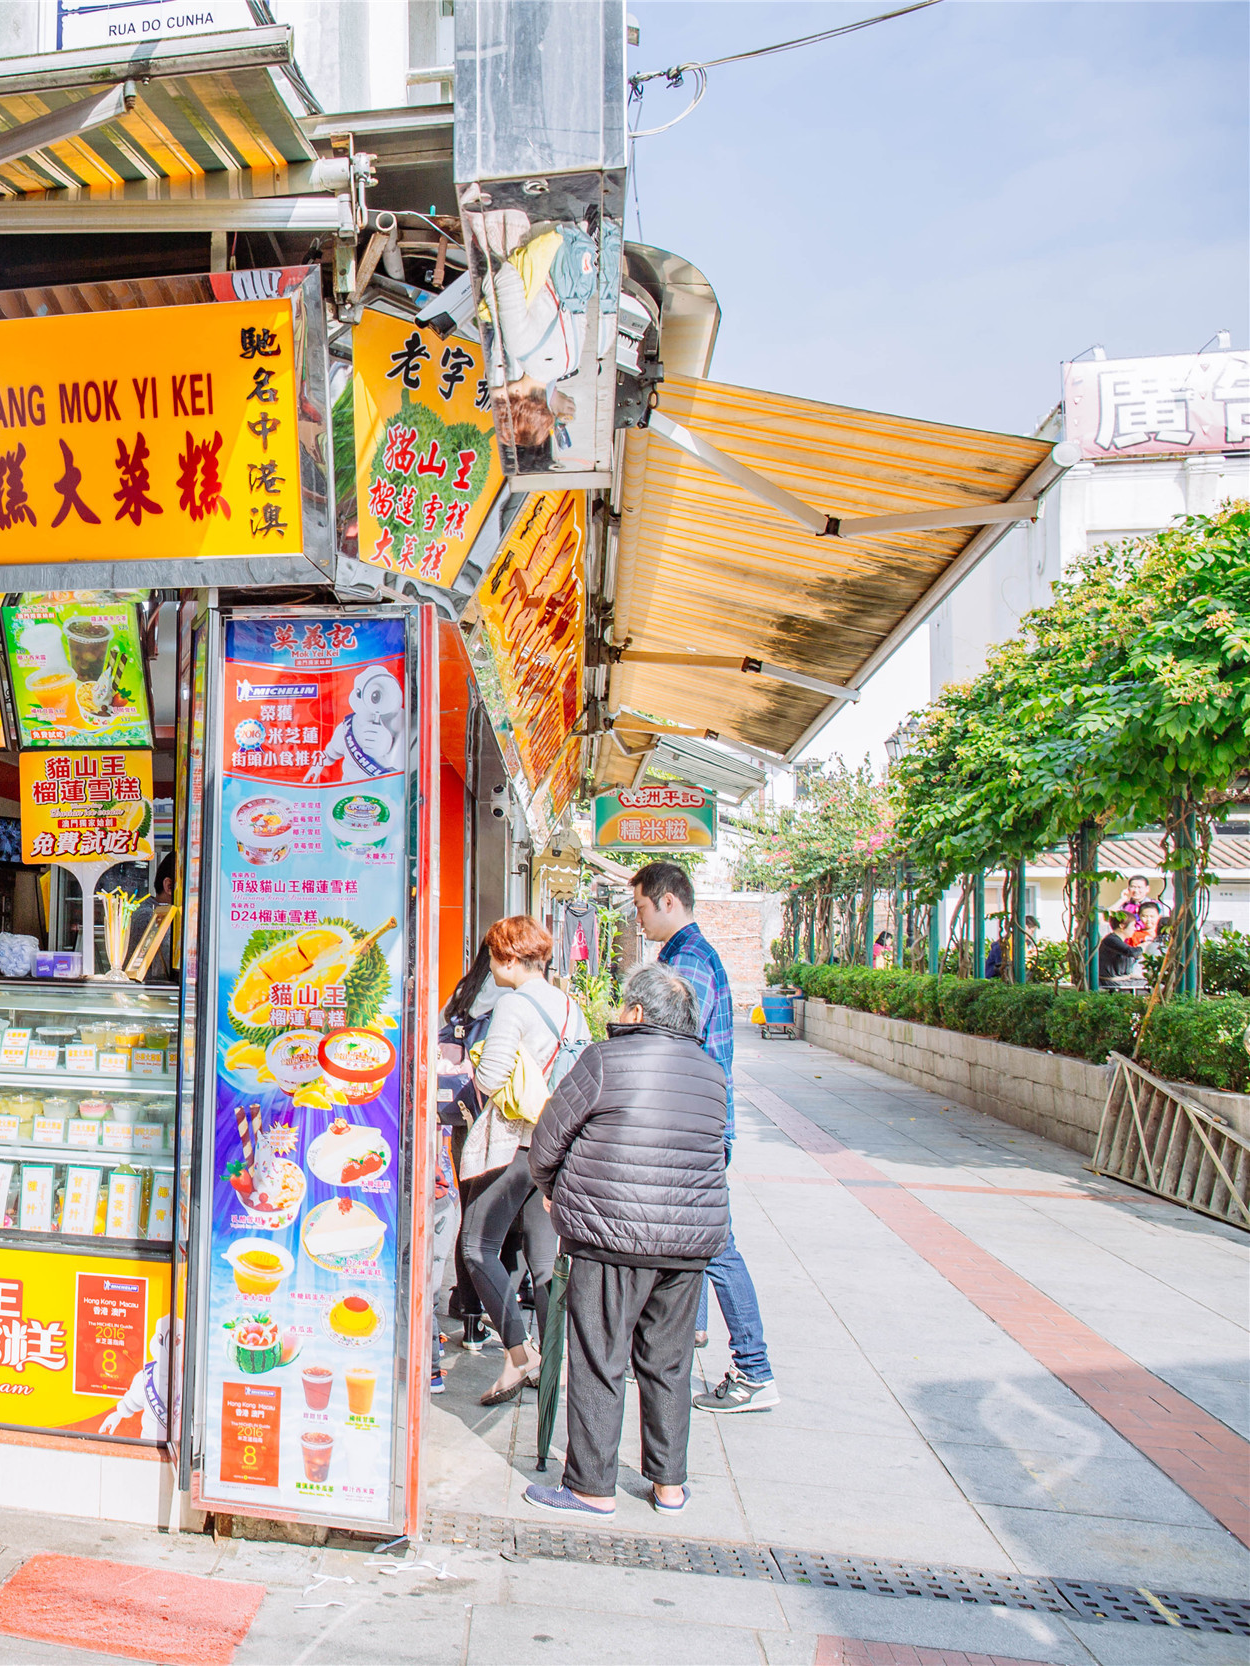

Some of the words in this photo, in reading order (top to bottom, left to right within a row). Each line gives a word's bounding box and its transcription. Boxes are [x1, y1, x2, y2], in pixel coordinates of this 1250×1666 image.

[108, 24, 136, 36] RUA
[141, 19, 161, 32] DO
[166, 12, 214, 29] CUNHA
[59, 380, 121, 424] MOK
[132, 377, 158, 419] YI
[172, 373, 213, 417] KEI
[239, 327, 288, 536] 馳名中港澳
[383, 424, 476, 491] 貓山王
[369, 475, 469, 541] 榴蓮雪糕
[370, 527, 447, 582] 大菜糕
[270, 622, 358, 651] 莫義記
[291, 650, 309, 658] Mok
[311, 650, 325, 659] Yei
[326, 650, 339, 658] Kei
[252, 686, 316, 696] MICHELIN
[260, 704, 293, 722] 榮獲
[267, 726, 319, 745] 米芝蓮
[45, 755, 127, 780] 貓山王
[231, 750, 327, 768] 街頭小食推介
[32, 777, 141, 804] 榴蓮雪糕
[619, 818, 688, 841] 糯米糍
[232, 880, 358, 894] 頂級貓山王榴蓮雪糕
[231, 909, 318, 923] D24榴蓮雪糕
[269, 983, 347, 1007] 貓山王
[270, 1008, 347, 1028] 榴蓮雪糕
[83, 1297, 100, 1306] Hong
[101, 1299, 117, 1307] Kong
[119, 1300, 139, 1309] Macau
[93, 1306, 108, 1316] 香港
[111, 1308, 126, 1318] 澳門
[95, 1326, 125, 1340] 2016
[102, 1349, 117, 1373] 8
[227, 1400, 241, 1408] Hong
[258, 1403, 275, 1411] Macau
[237, 1426, 263, 1437] 2016
[243, 1445, 256, 1465] 8
